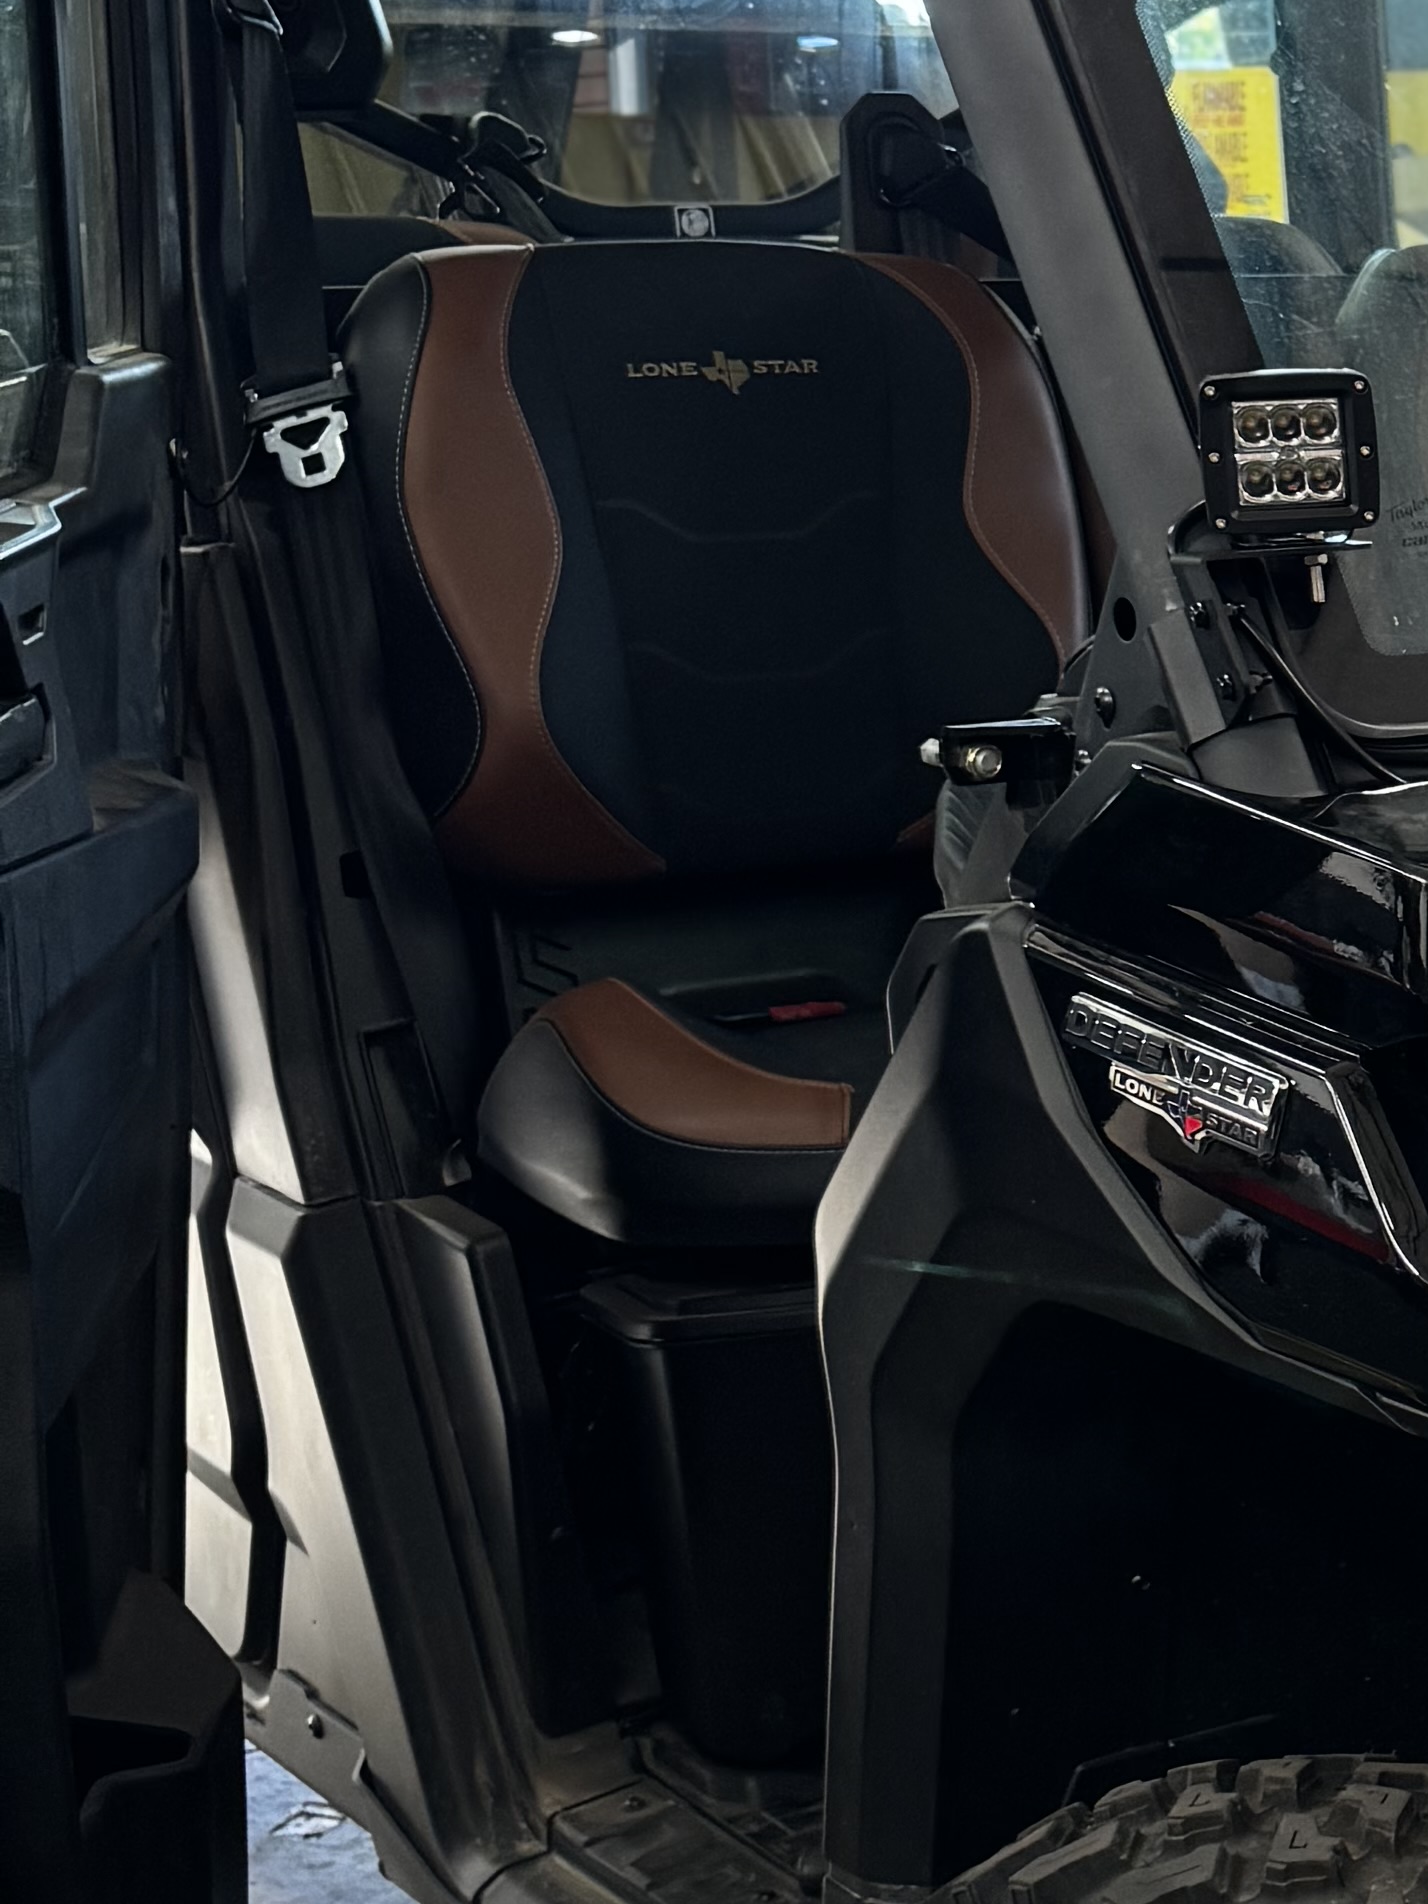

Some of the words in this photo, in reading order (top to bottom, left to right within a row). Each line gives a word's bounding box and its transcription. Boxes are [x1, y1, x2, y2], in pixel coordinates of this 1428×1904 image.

[626, 361, 699, 378] LONE
[753, 358, 819, 375] STAR
[1065, 1003, 1278, 1117] DEFENDER
[1113, 1072, 1166, 1107] LONE
[1205, 1112, 1259, 1144] STAR
